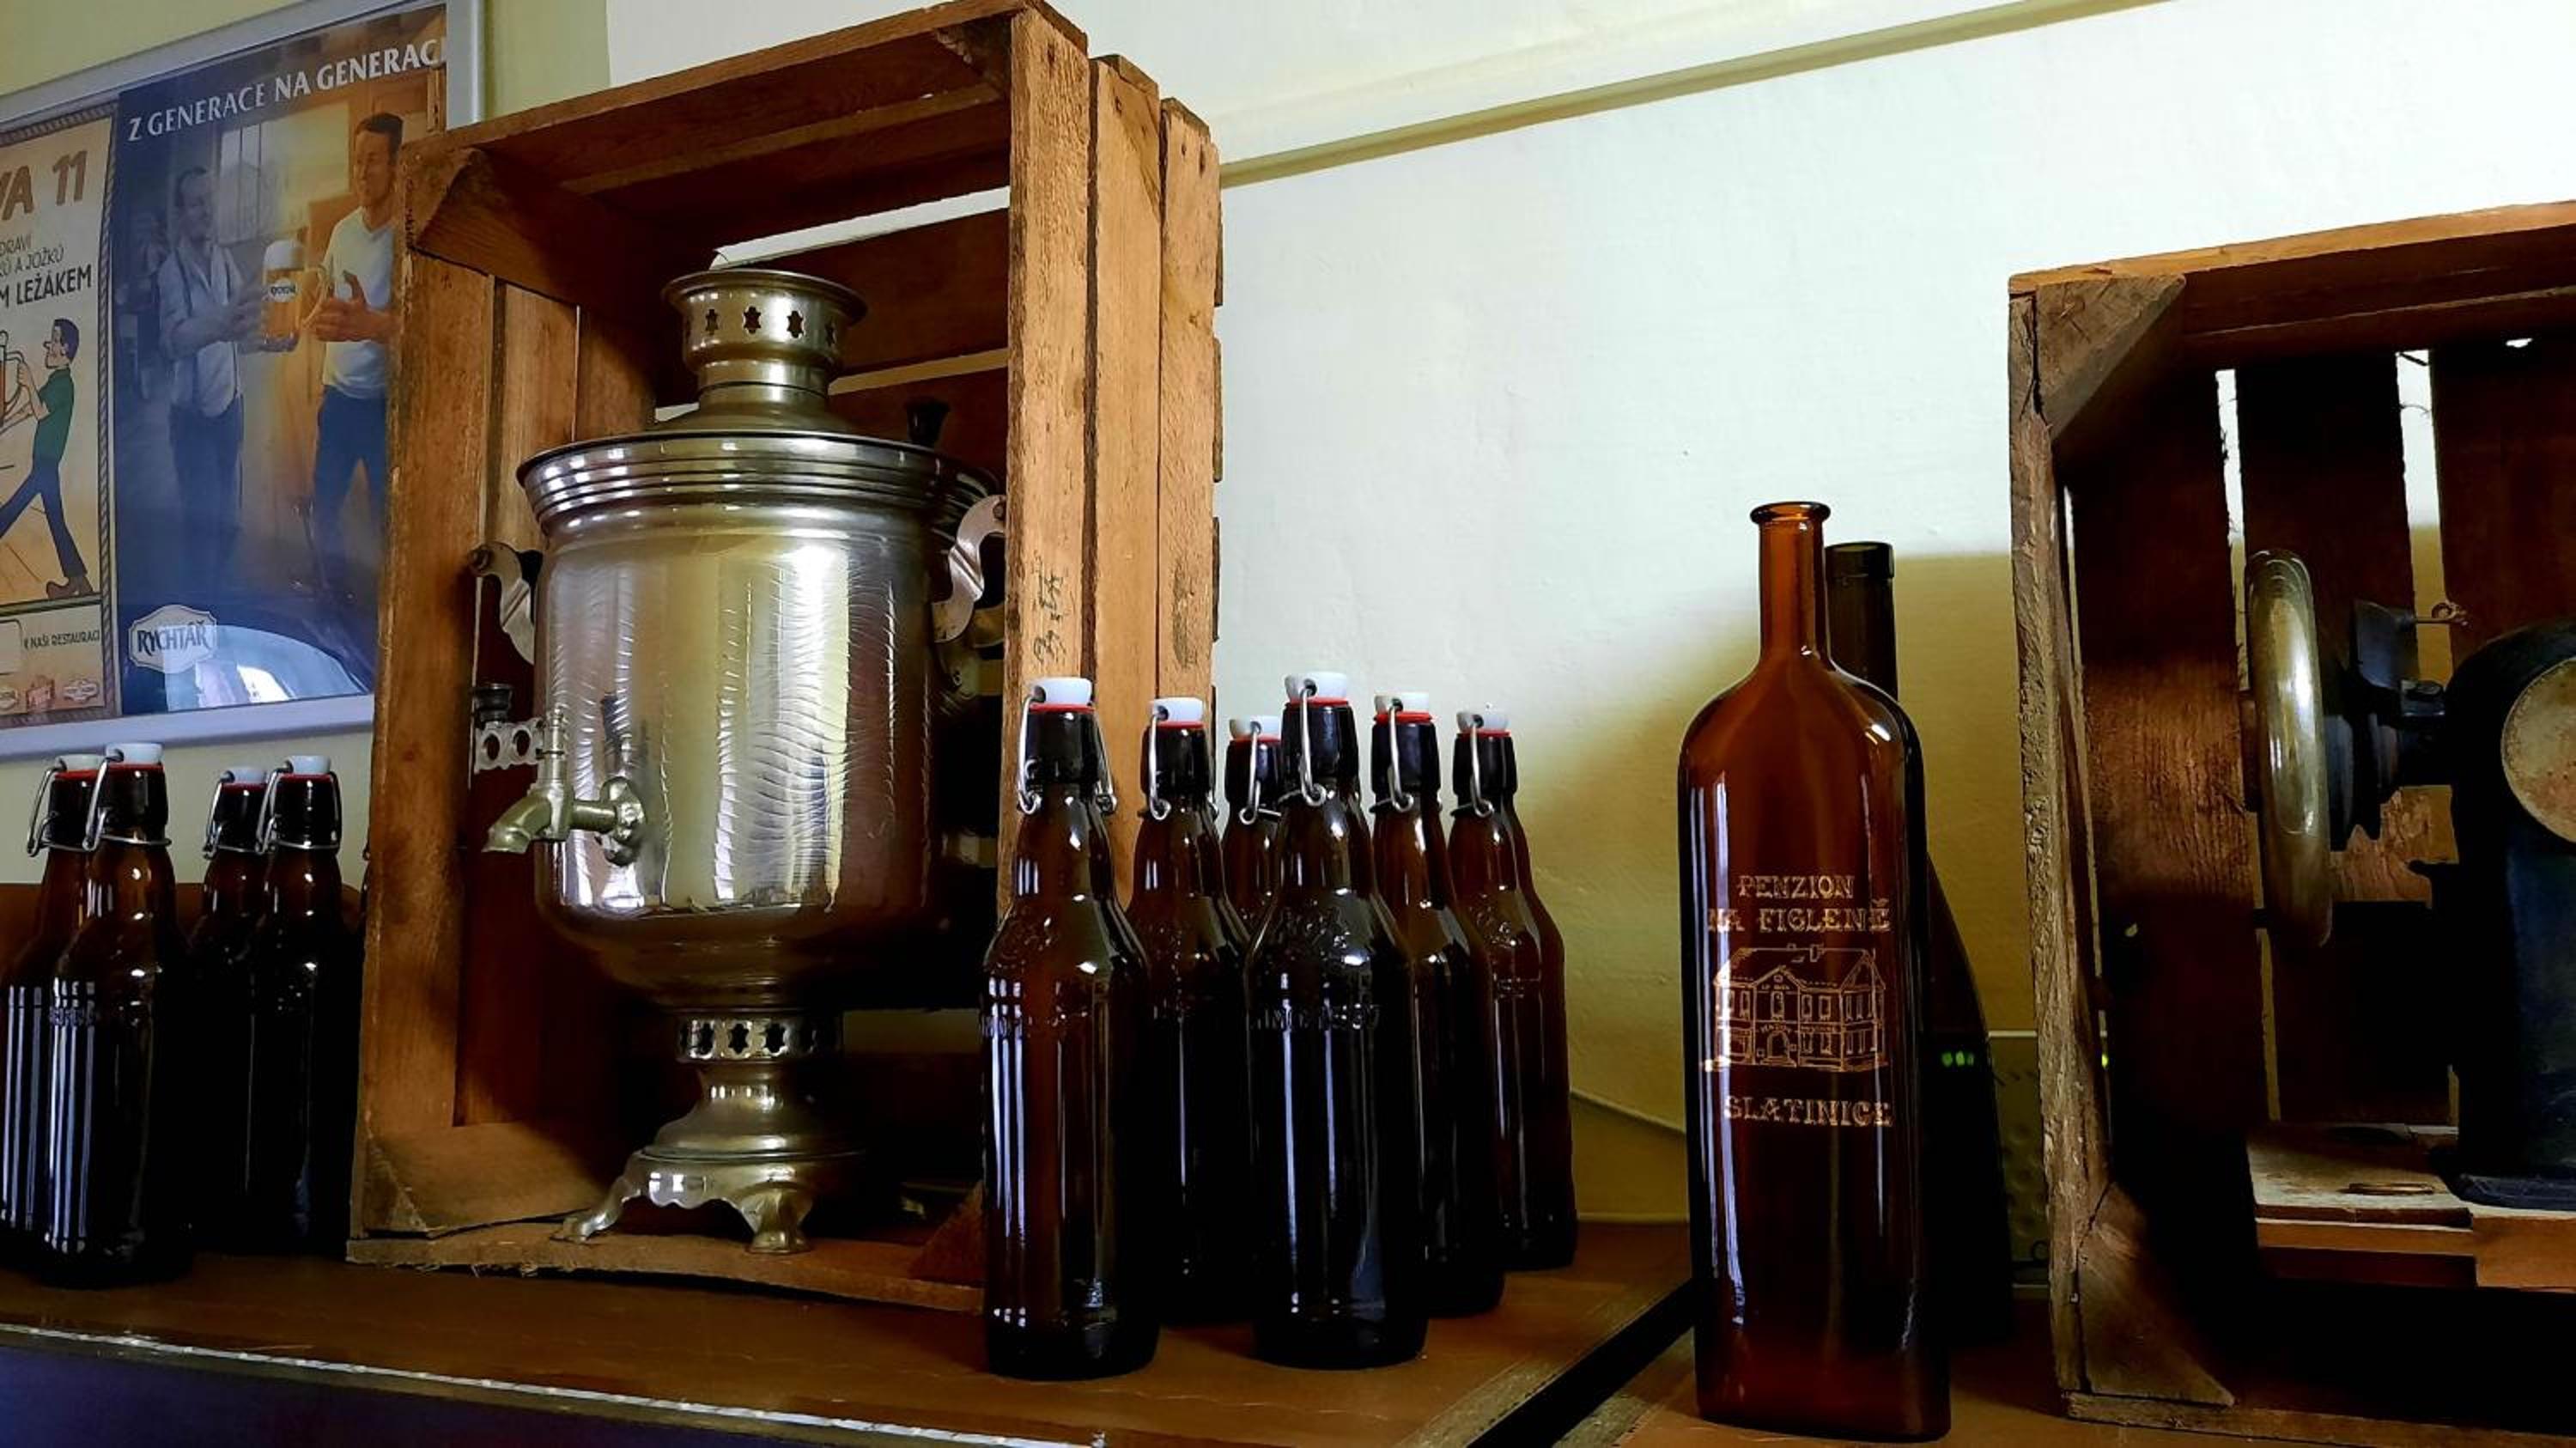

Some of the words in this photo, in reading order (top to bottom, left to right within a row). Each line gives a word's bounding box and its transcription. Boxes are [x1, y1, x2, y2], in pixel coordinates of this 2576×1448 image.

[128, 117, 143, 142] Z
[147, 83, 265, 137] GENERACE
[275, 71, 312, 102] NA
[16, 263, 92, 306] LEŽÁKEM
[1737, 874, 1855, 900] PENZION
[1725, 1097, 1893, 1128] SLATINICE
